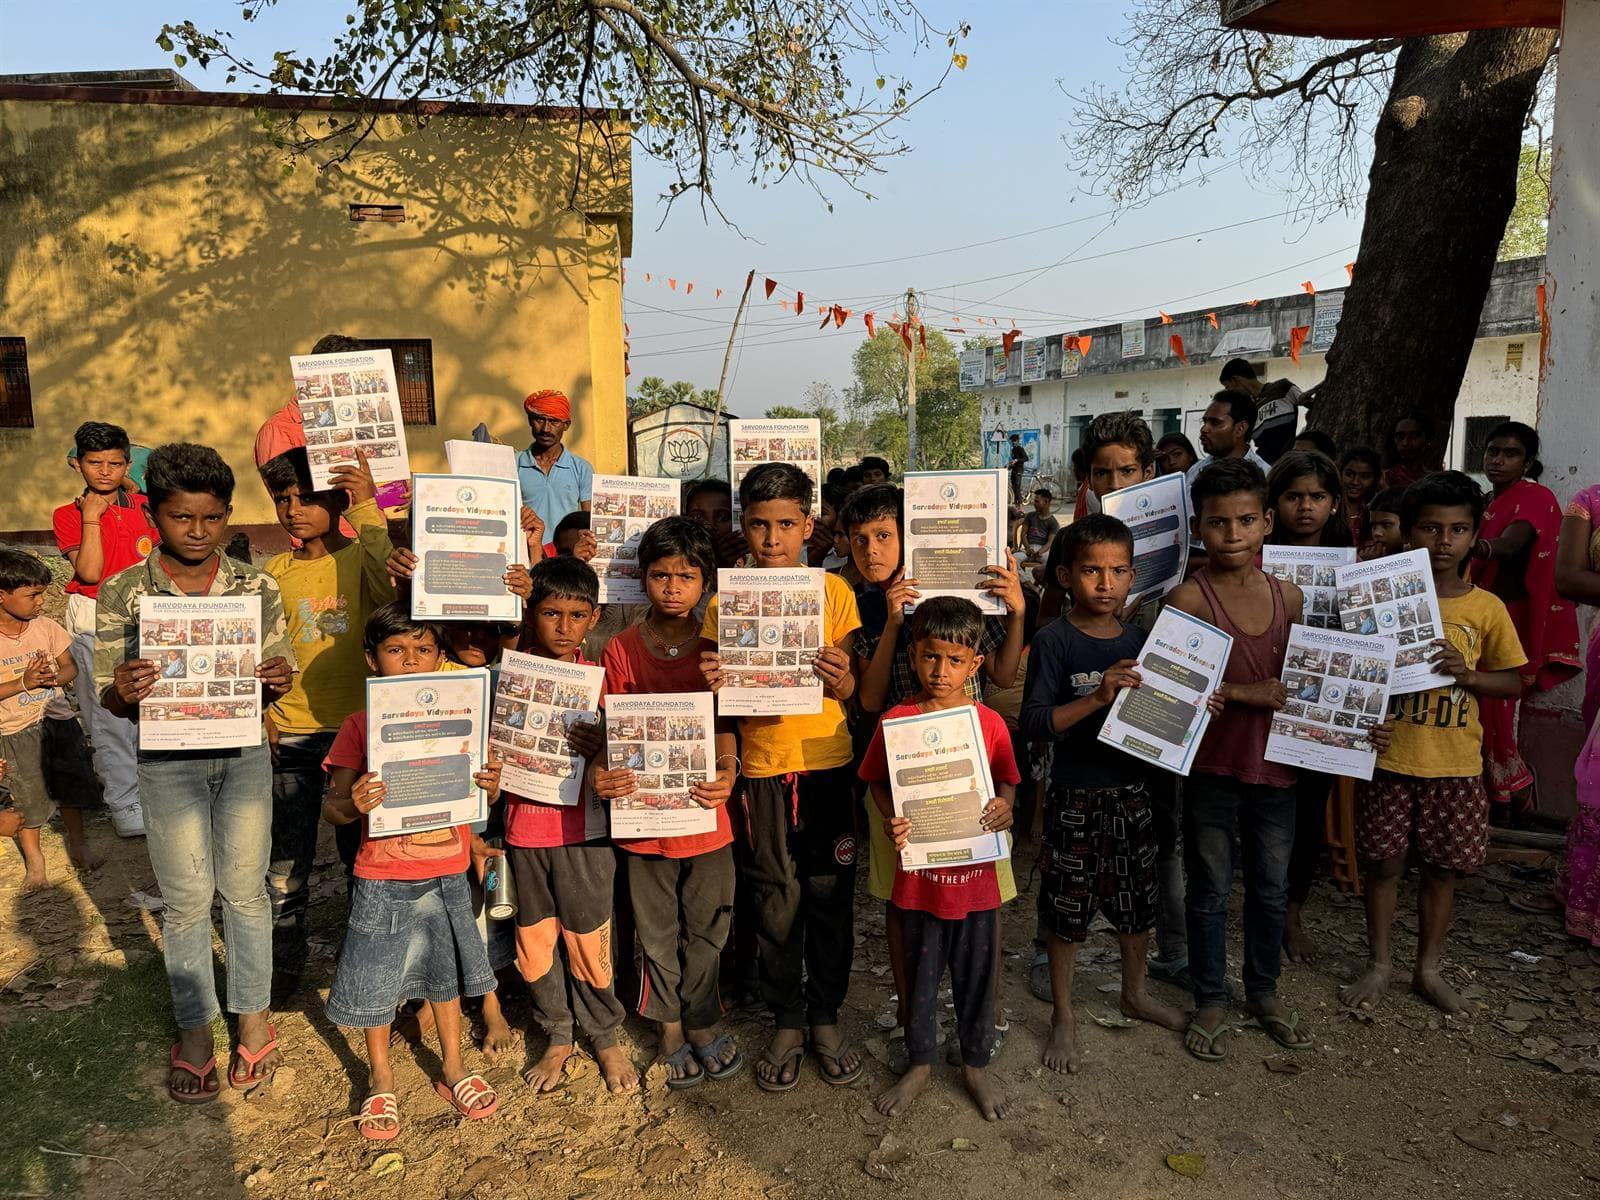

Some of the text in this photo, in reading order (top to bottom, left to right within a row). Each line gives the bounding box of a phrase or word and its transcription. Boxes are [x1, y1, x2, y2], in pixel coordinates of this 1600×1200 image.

[1302, 630, 1340, 642] SARVODAYA
[1341, 638, 1385, 649] FOUNDATION
[2, 656, 23, 666] NEW
[545, 665, 586, 676] FOUNDATION
[941, 875, 958, 884] THE
